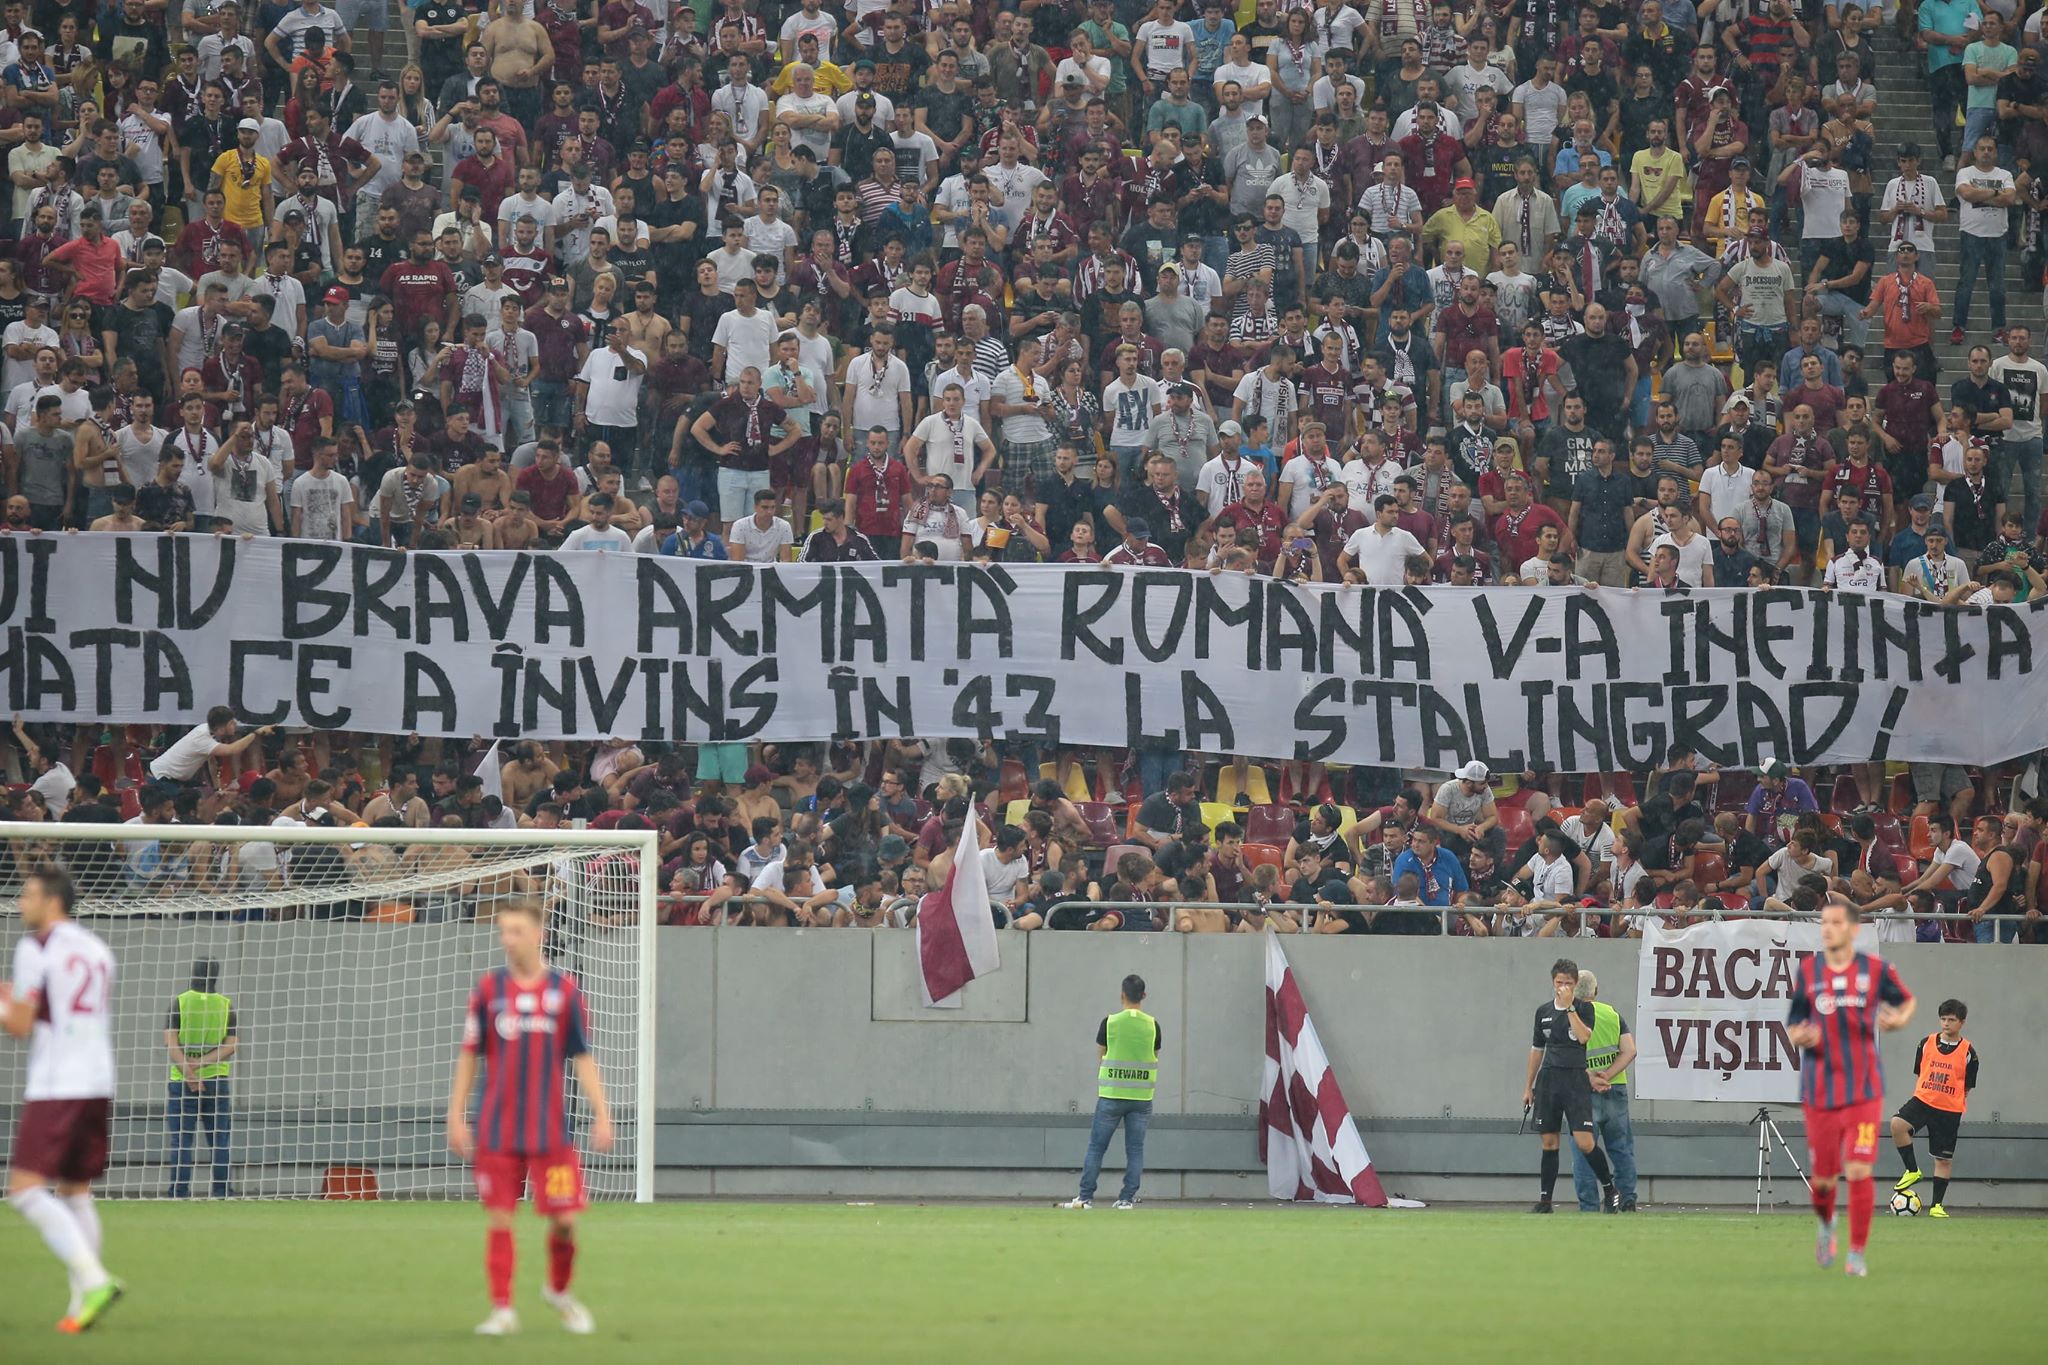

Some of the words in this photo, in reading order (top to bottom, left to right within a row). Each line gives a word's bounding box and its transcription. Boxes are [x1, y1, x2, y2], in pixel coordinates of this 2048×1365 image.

[369, 247, 383, 258] 14
[115, 536, 237, 632] NU
[282, 542, 585, 648] BRAVA
[1473, 592, 1622, 682] V-A
[228, 639, 352, 729] CE
[402, 651, 458, 733] A
[491, 643, 778, 741] ÎNVINS
[827, 665, 915, 741] ÎN
[1124, 670, 1235, 751] LA
[1107, 1068, 1150, 1080] STEWARD
[1655, 1018, 1800, 1082] VIȘIN
